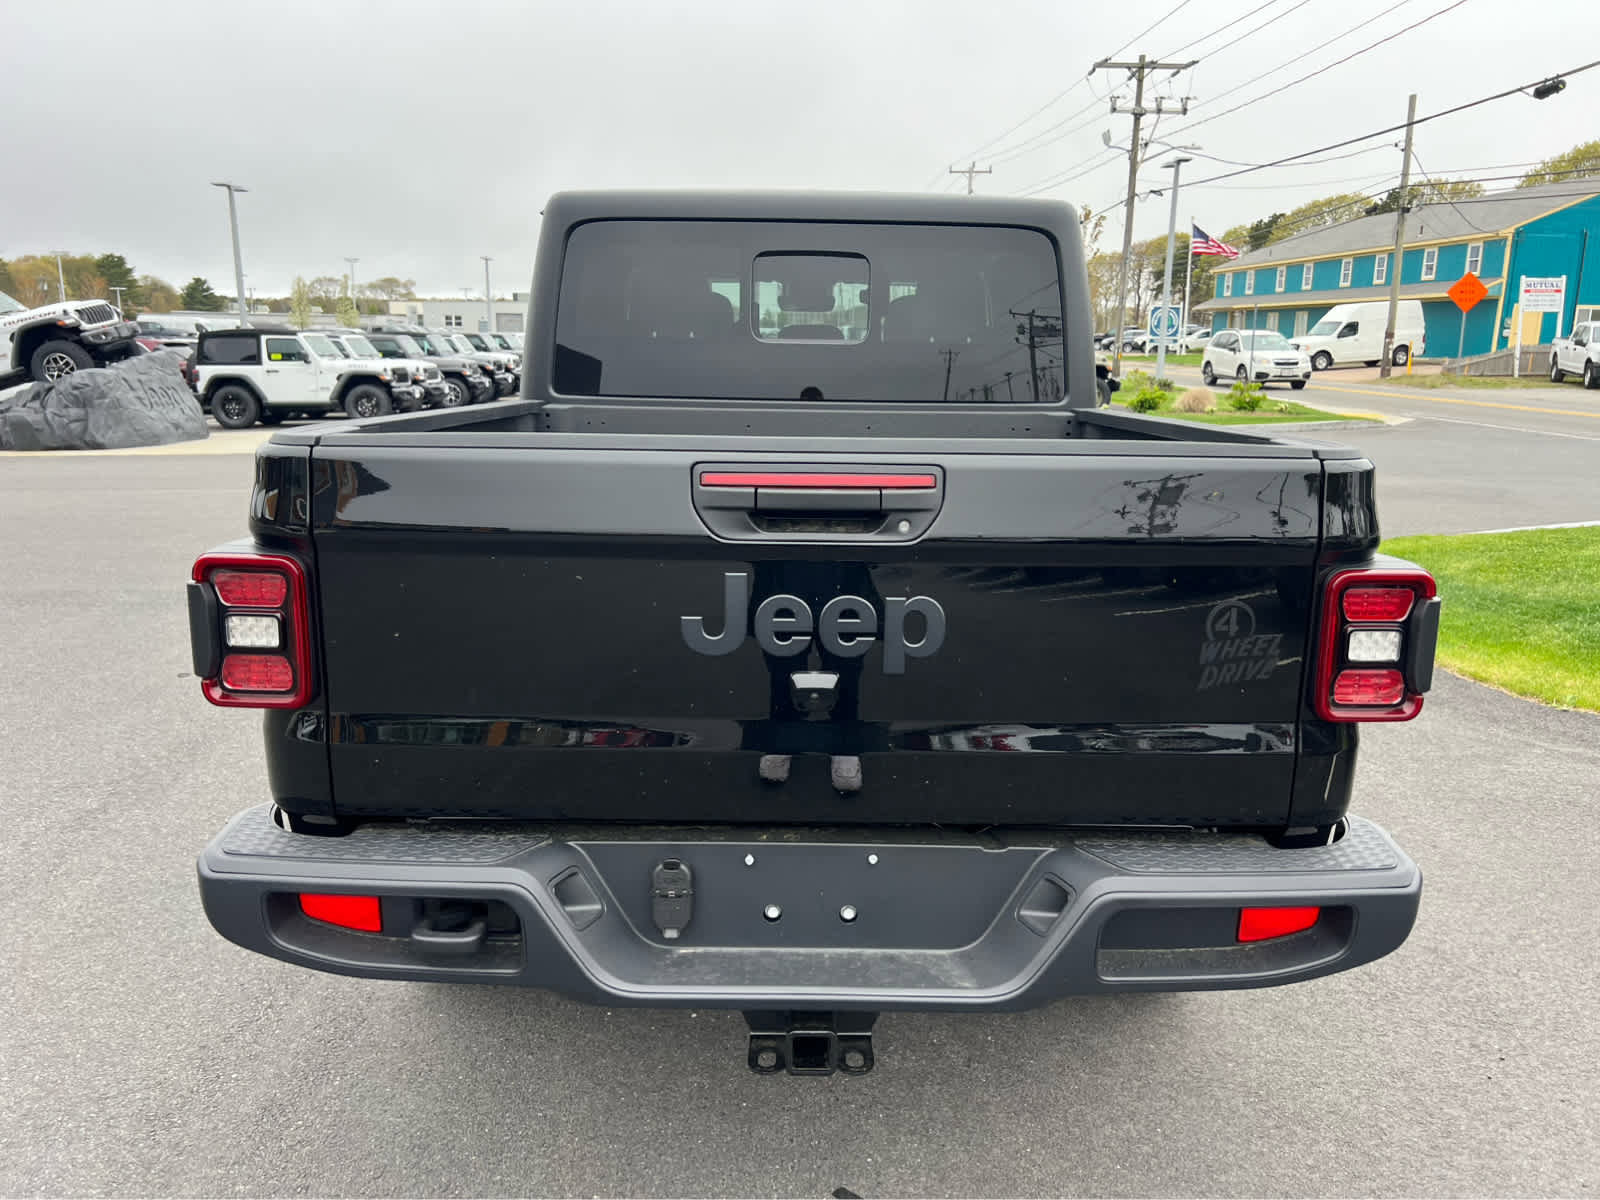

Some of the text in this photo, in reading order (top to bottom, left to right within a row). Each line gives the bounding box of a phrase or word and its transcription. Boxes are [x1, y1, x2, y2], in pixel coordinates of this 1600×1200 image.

[1525, 281, 1560, 289] MUTUAL
[680, 571, 947, 675] Jeep
[1215, 607, 1239, 637] 4
[1199, 633, 1284, 665] WHEEL
[1197, 658, 1280, 691] DRIVE
